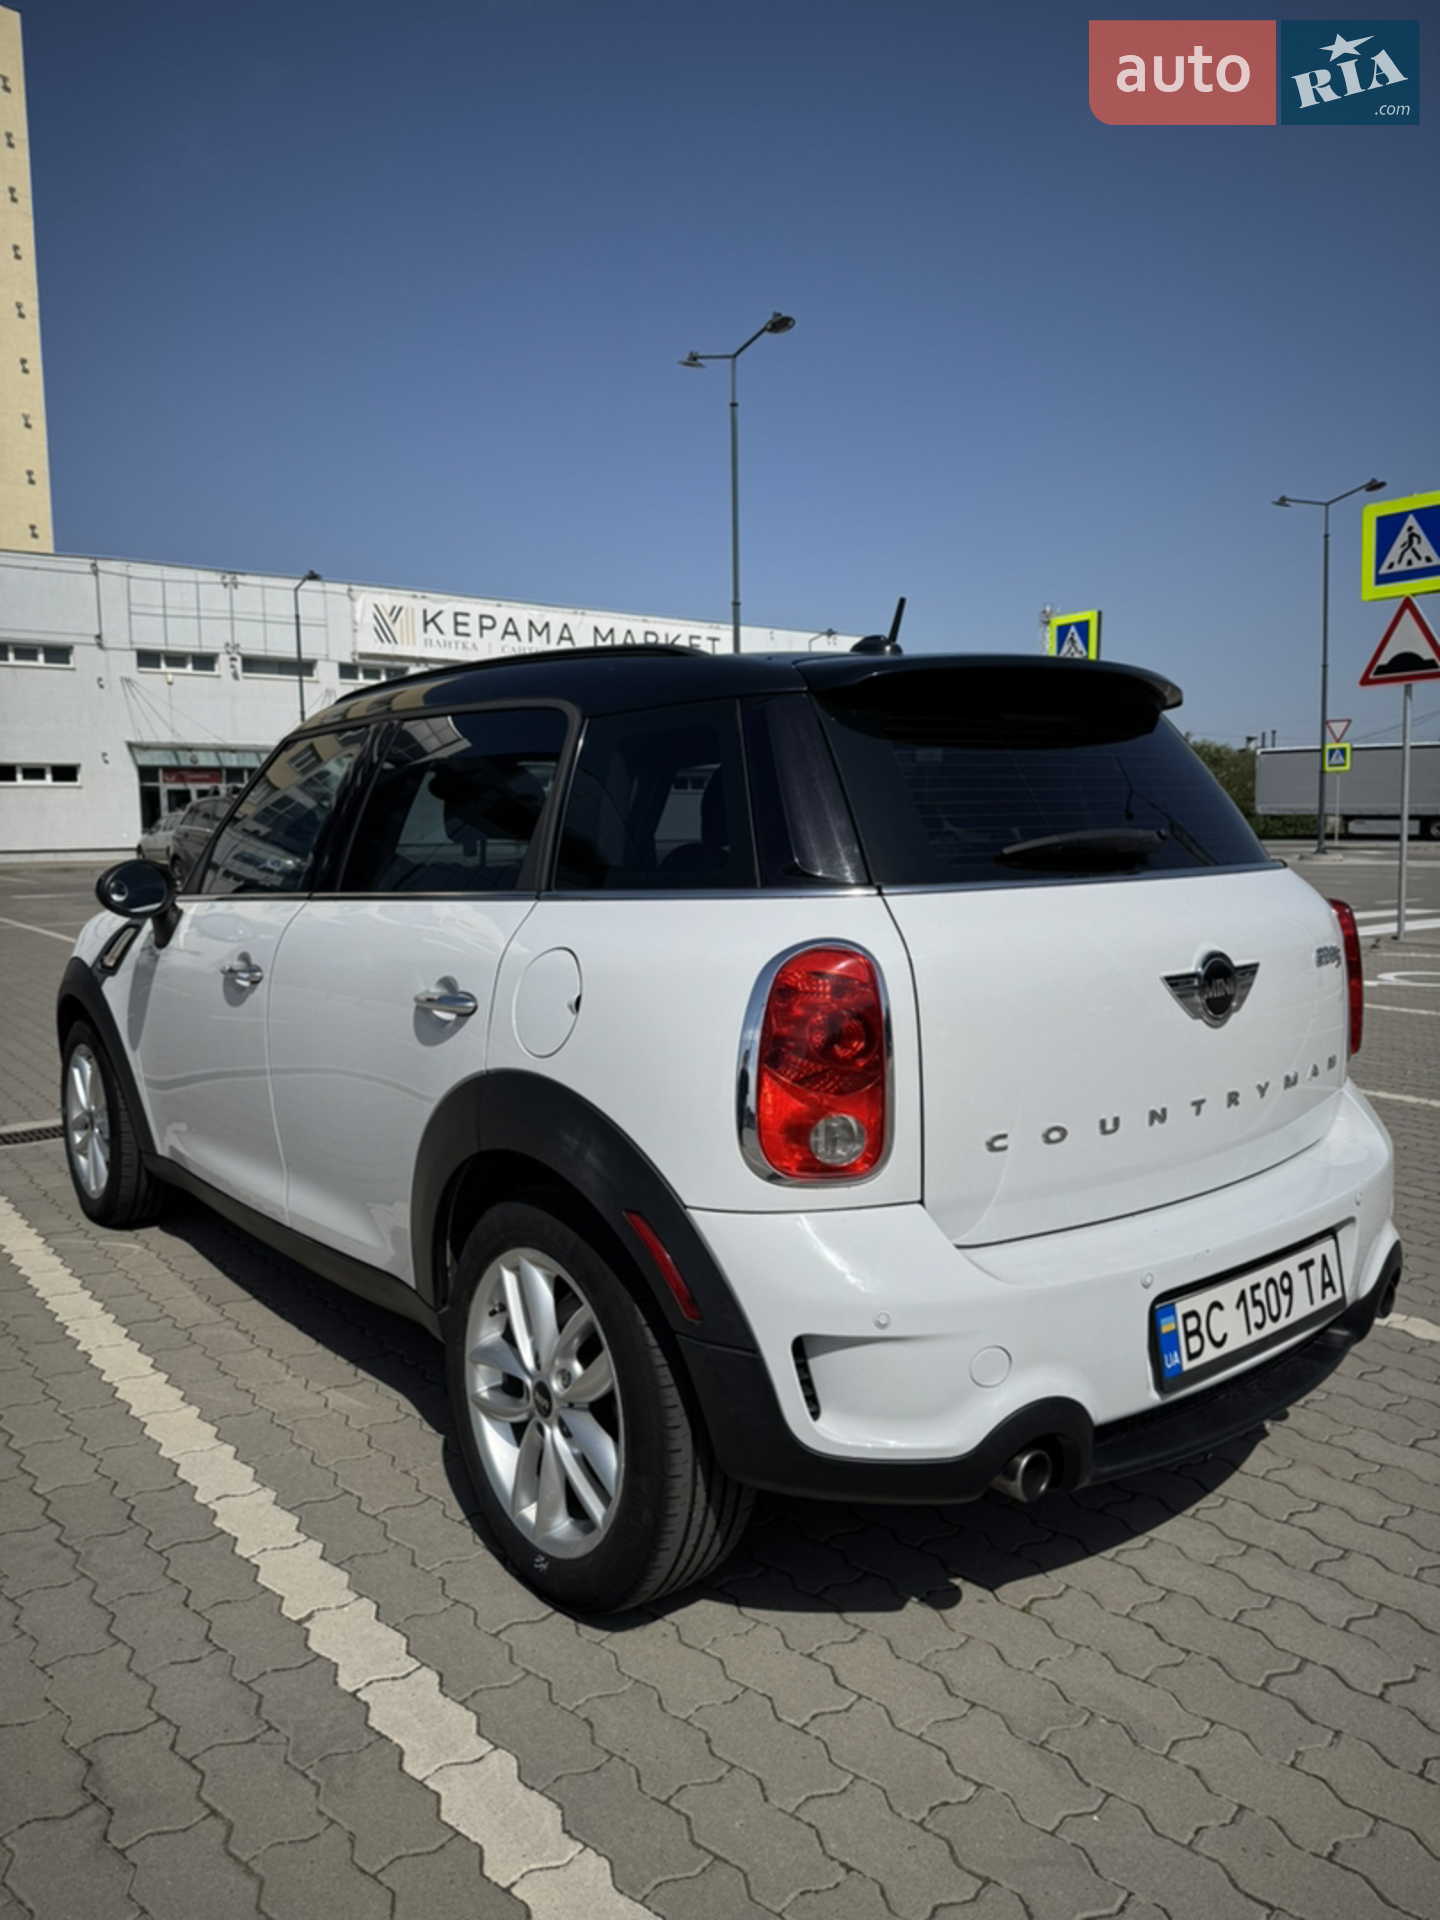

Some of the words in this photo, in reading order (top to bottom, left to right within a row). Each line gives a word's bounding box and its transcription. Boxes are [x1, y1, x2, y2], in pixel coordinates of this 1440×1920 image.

[1203, 977, 1235, 999] MINI
[985, 1054, 1338, 1154] COUNTRYMAN
[1181, 1300, 1229, 1362] BC
[1235, 1270, 1294, 1336] 1509
[1298, 1253, 1338, 1306] TA
[1164, 1351, 1181, 1368] UA
